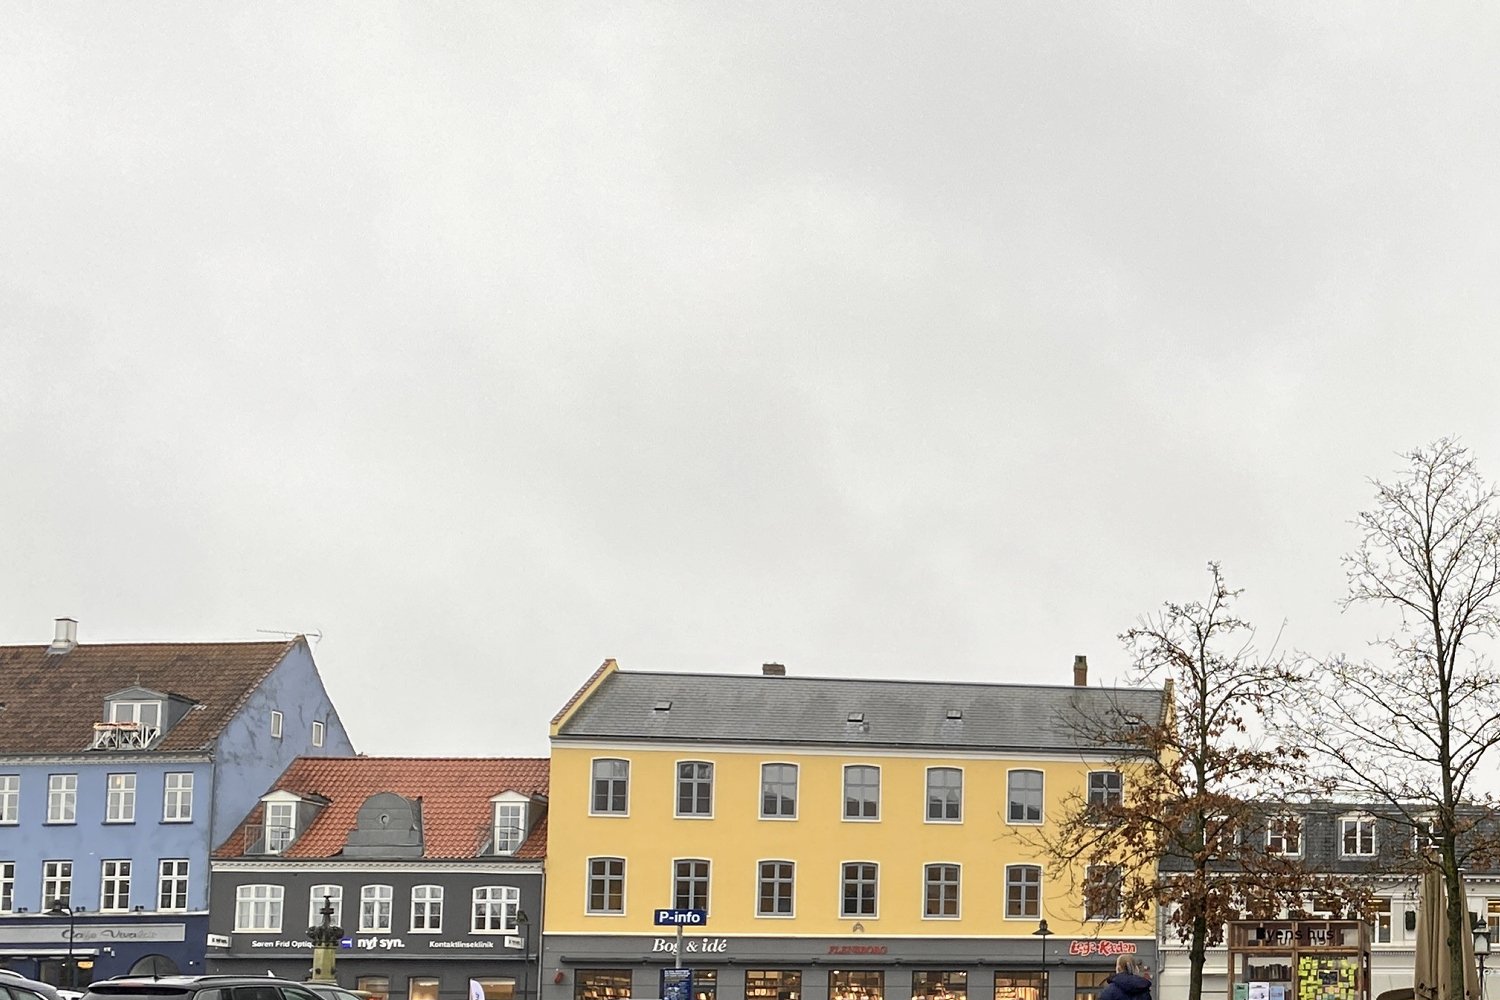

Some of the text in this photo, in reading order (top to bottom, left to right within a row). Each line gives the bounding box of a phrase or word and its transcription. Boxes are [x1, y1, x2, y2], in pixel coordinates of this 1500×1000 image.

[659, 911, 701, 923] P-info
[1307, 927, 1335, 940] hus
[252, 940, 274, 948] Søren
[275, 940, 290, 948] Frid
[358, 937, 377, 950] nyt
[429, 940, 493, 948] Kontaktlinseklinik
[686, 940, 699, 953] &
[702, 937, 727, 953] idé
